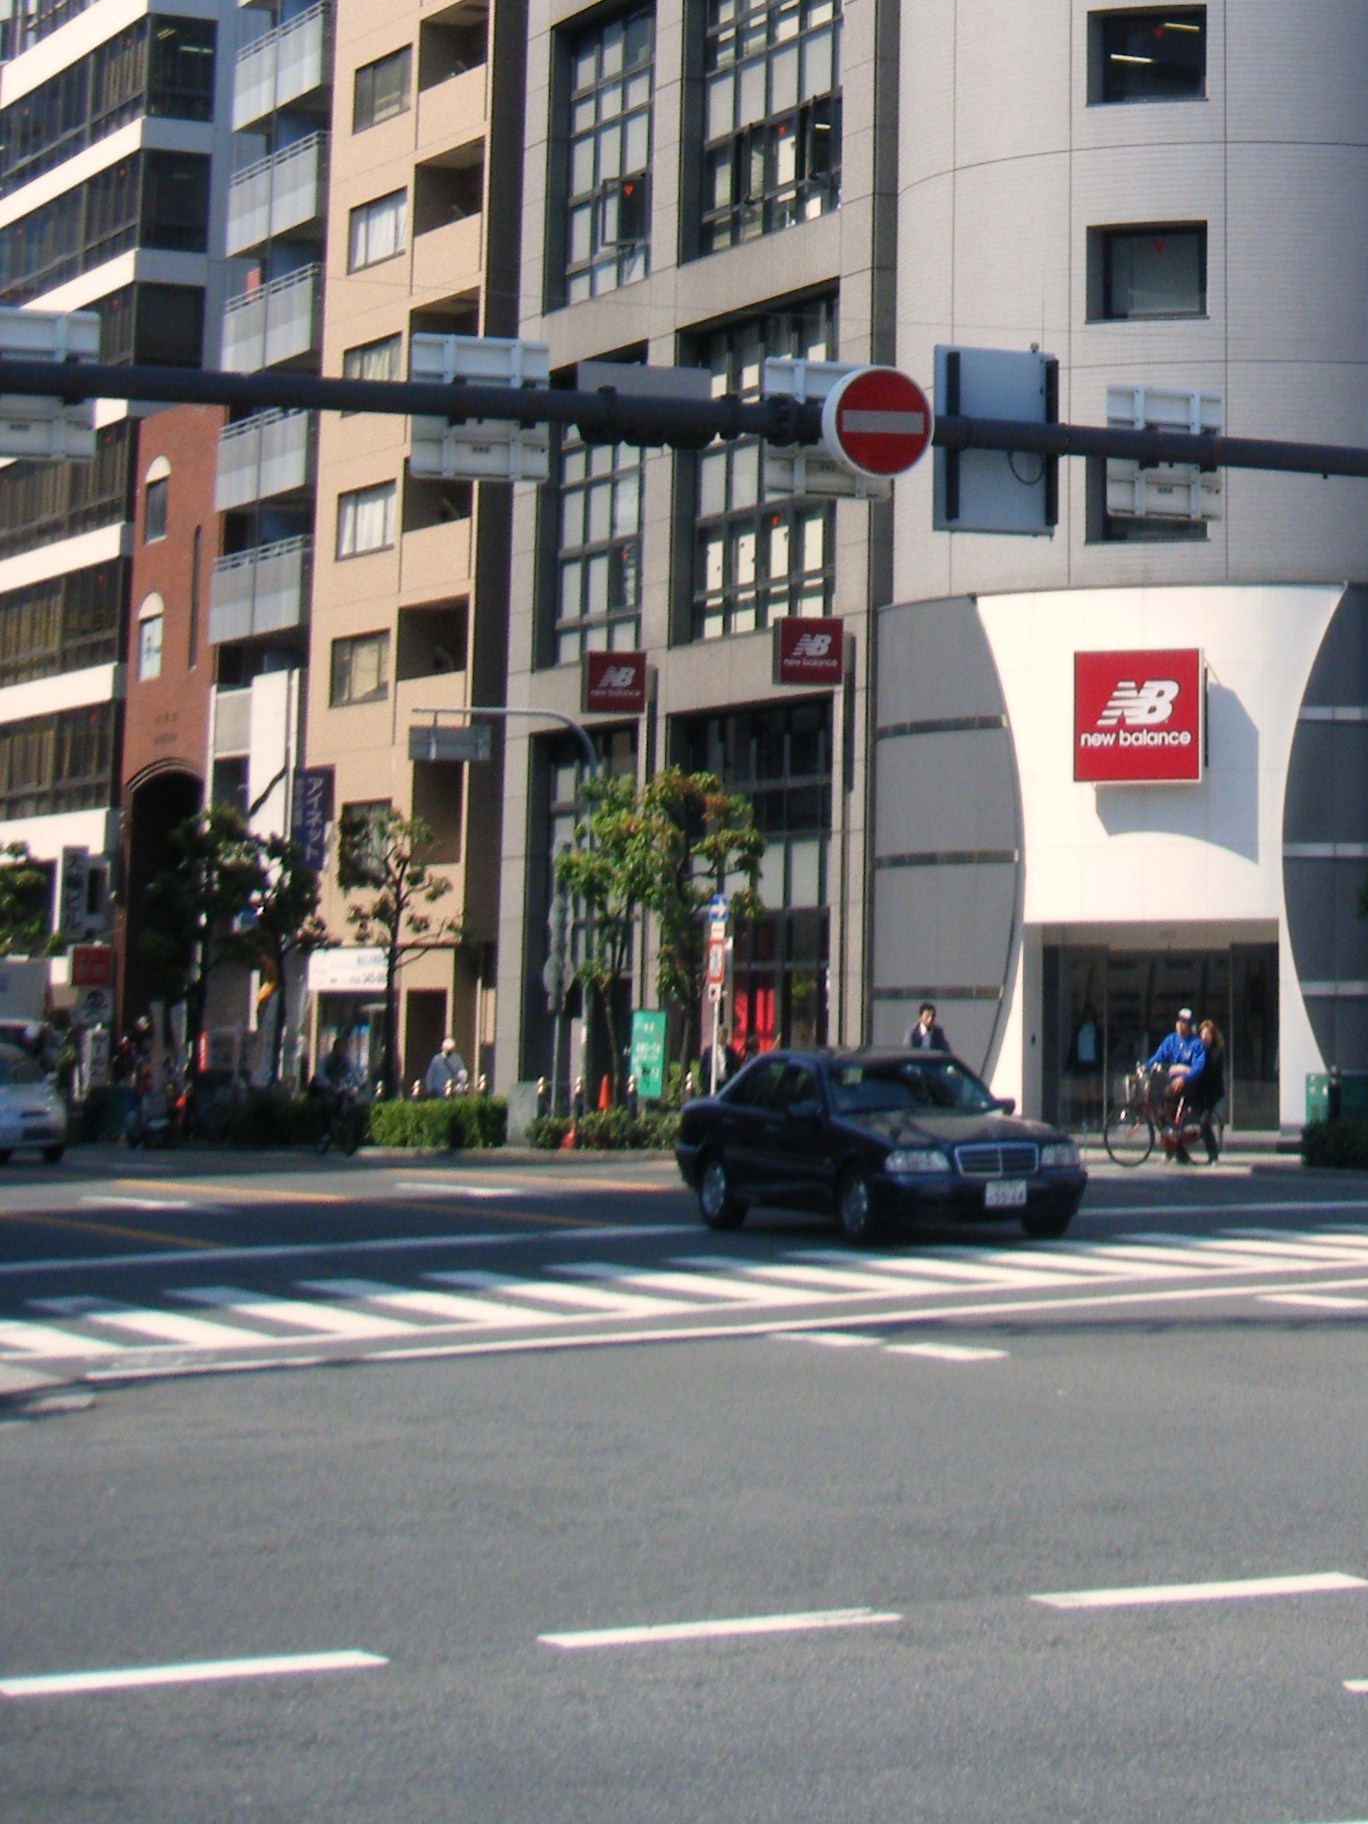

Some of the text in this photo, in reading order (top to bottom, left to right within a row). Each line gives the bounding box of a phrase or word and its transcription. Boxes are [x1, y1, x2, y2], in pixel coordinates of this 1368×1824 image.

[792, 633, 832, 656] NB
[803, 658, 838, 667] balance
[598, 666, 636, 688] NB
[1096, 679, 1180, 726] NB
[1080, 728, 1191, 747] new balance
